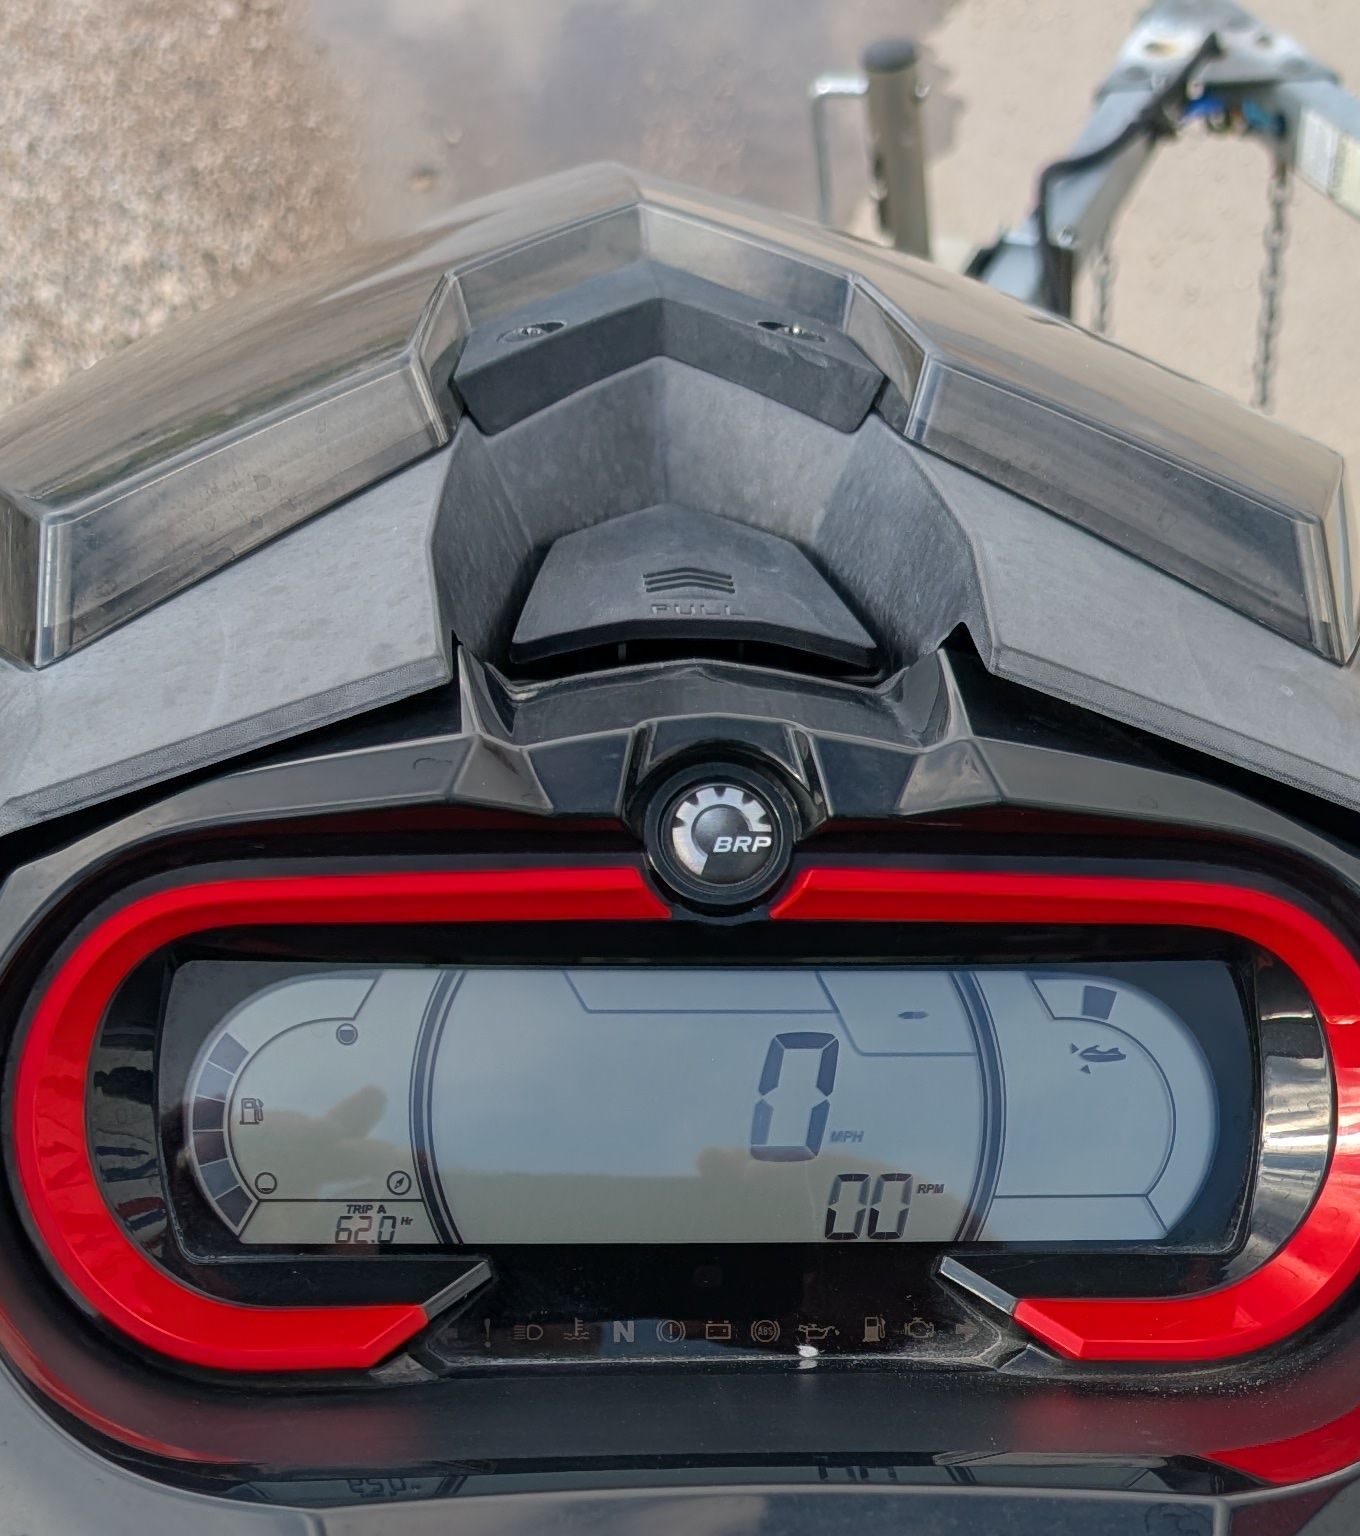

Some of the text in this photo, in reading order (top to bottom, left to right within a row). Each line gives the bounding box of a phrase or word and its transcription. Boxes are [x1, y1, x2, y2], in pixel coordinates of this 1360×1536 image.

[650, 603, 745, 617] PULL
[712, 836, 773, 853] BRP
[750, 1032, 865, 1162] 0 MPH
[346, 1204, 387, 1214] TRIP A
[825, 1173, 945, 1240] 00 RPM
[334, 1215, 414, 1244] 62.0 Hr
[613, 1320, 635, 1343] N
[757, 1326, 774, 1337] ABS
